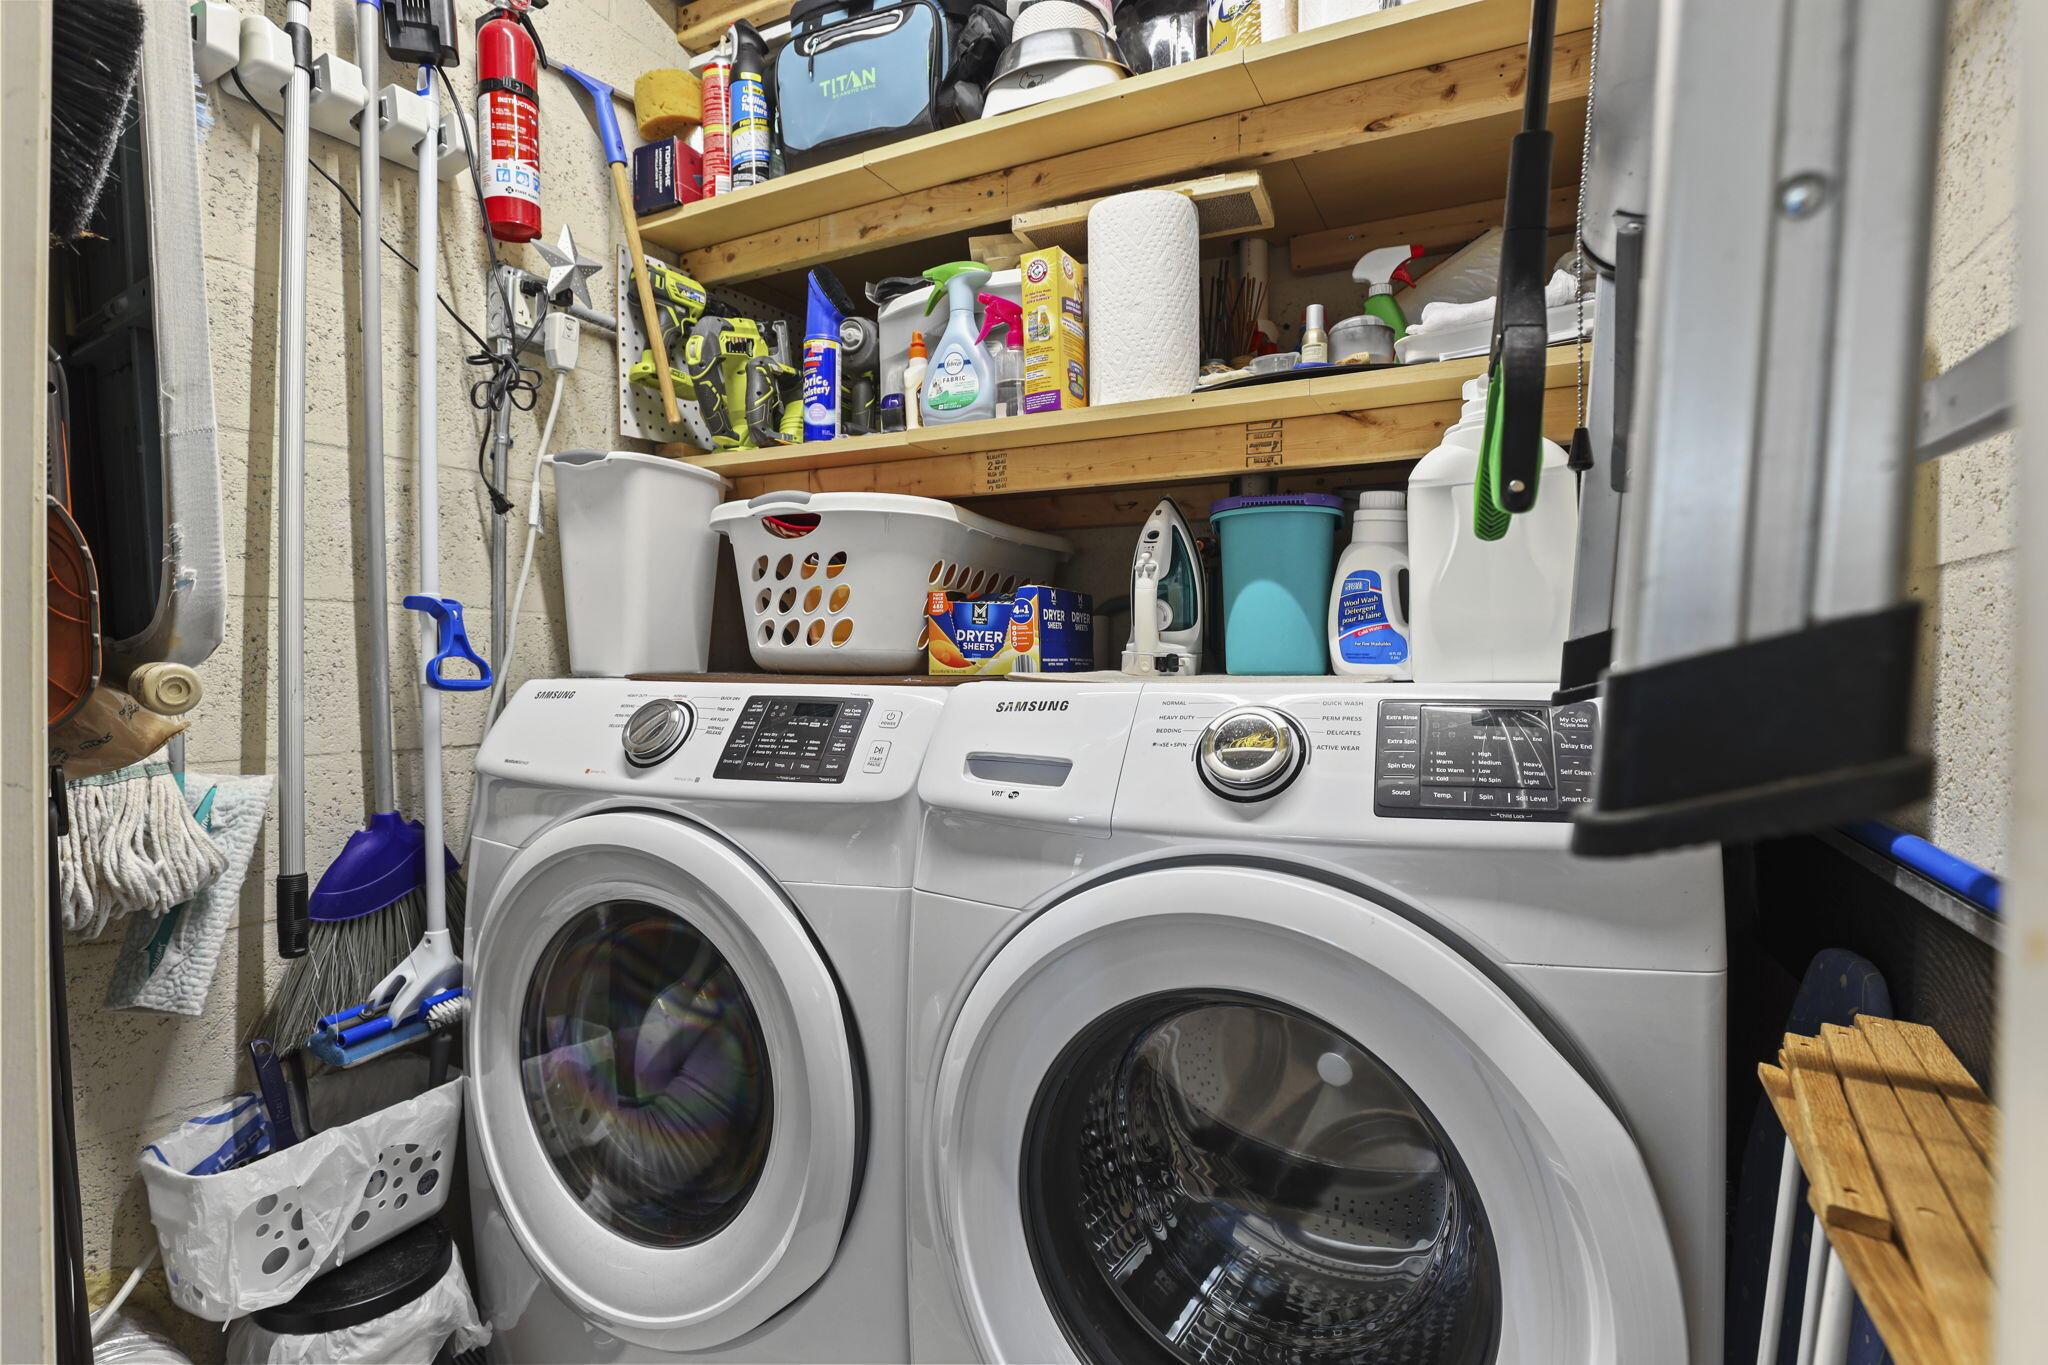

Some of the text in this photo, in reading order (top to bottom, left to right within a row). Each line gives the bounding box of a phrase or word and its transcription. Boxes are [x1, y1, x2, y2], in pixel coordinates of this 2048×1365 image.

[819, 67, 876, 97] TITAN
[753, 117, 768, 125] RADE
[942, 375, 966, 383] FABRIC
[987, 461, 993, 471] 2
[1360, 595, 1379, 605] Wash
[1042, 608, 1066, 622] DRYER
[1071, 611, 1091, 625] DRYER
[1047, 621, 1063, 630] SHEETS
[1342, 618, 1356, 626] pour
[956, 630, 1003, 644] DRYER
[962, 642, 995, 651] SHEETS
[534, 691, 576, 699] SAMSUNG
[995, 700, 1070, 712] SAMSUNG
